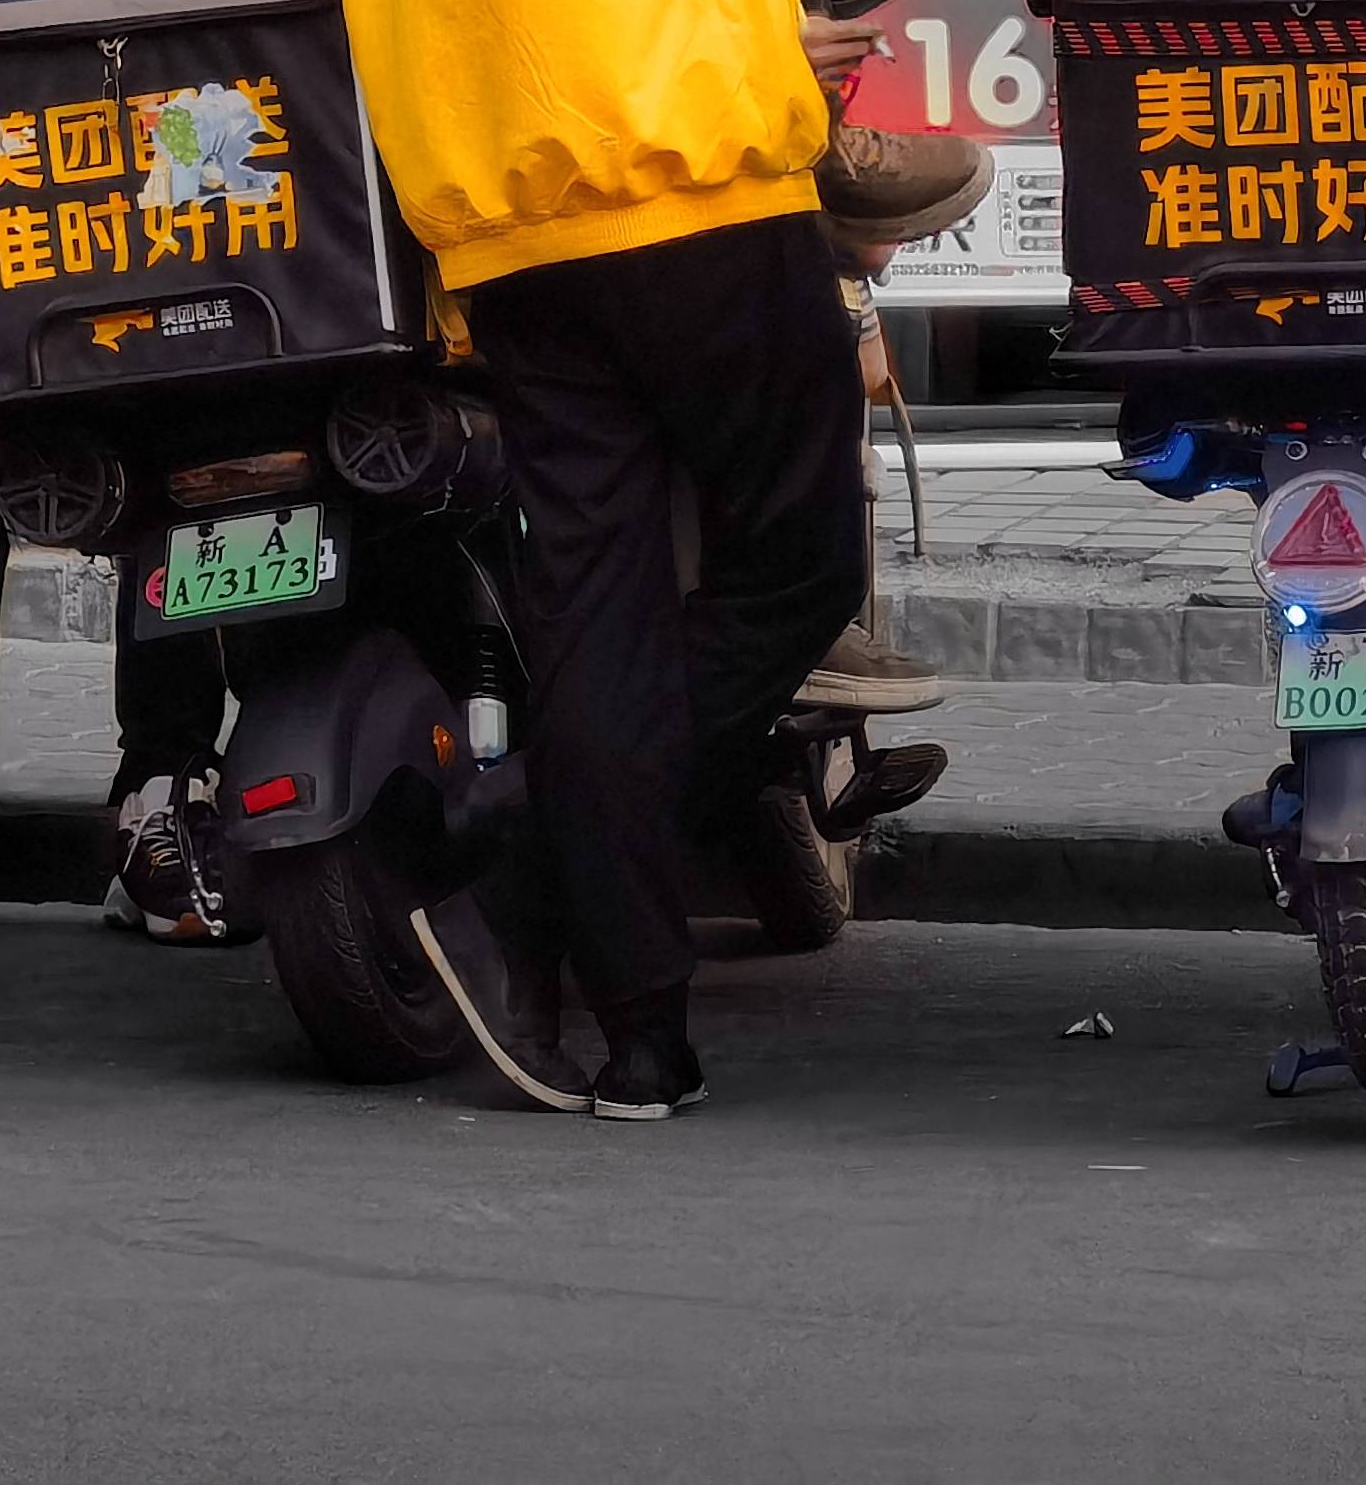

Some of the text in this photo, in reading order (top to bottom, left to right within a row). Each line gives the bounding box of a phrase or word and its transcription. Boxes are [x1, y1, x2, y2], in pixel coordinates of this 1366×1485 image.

[905, 17, 1044, 128] 16
[195, 526, 289, 569] 新 A
[171, 557, 310, 609] A73173
[1308, 649, 1343, 680] 新
